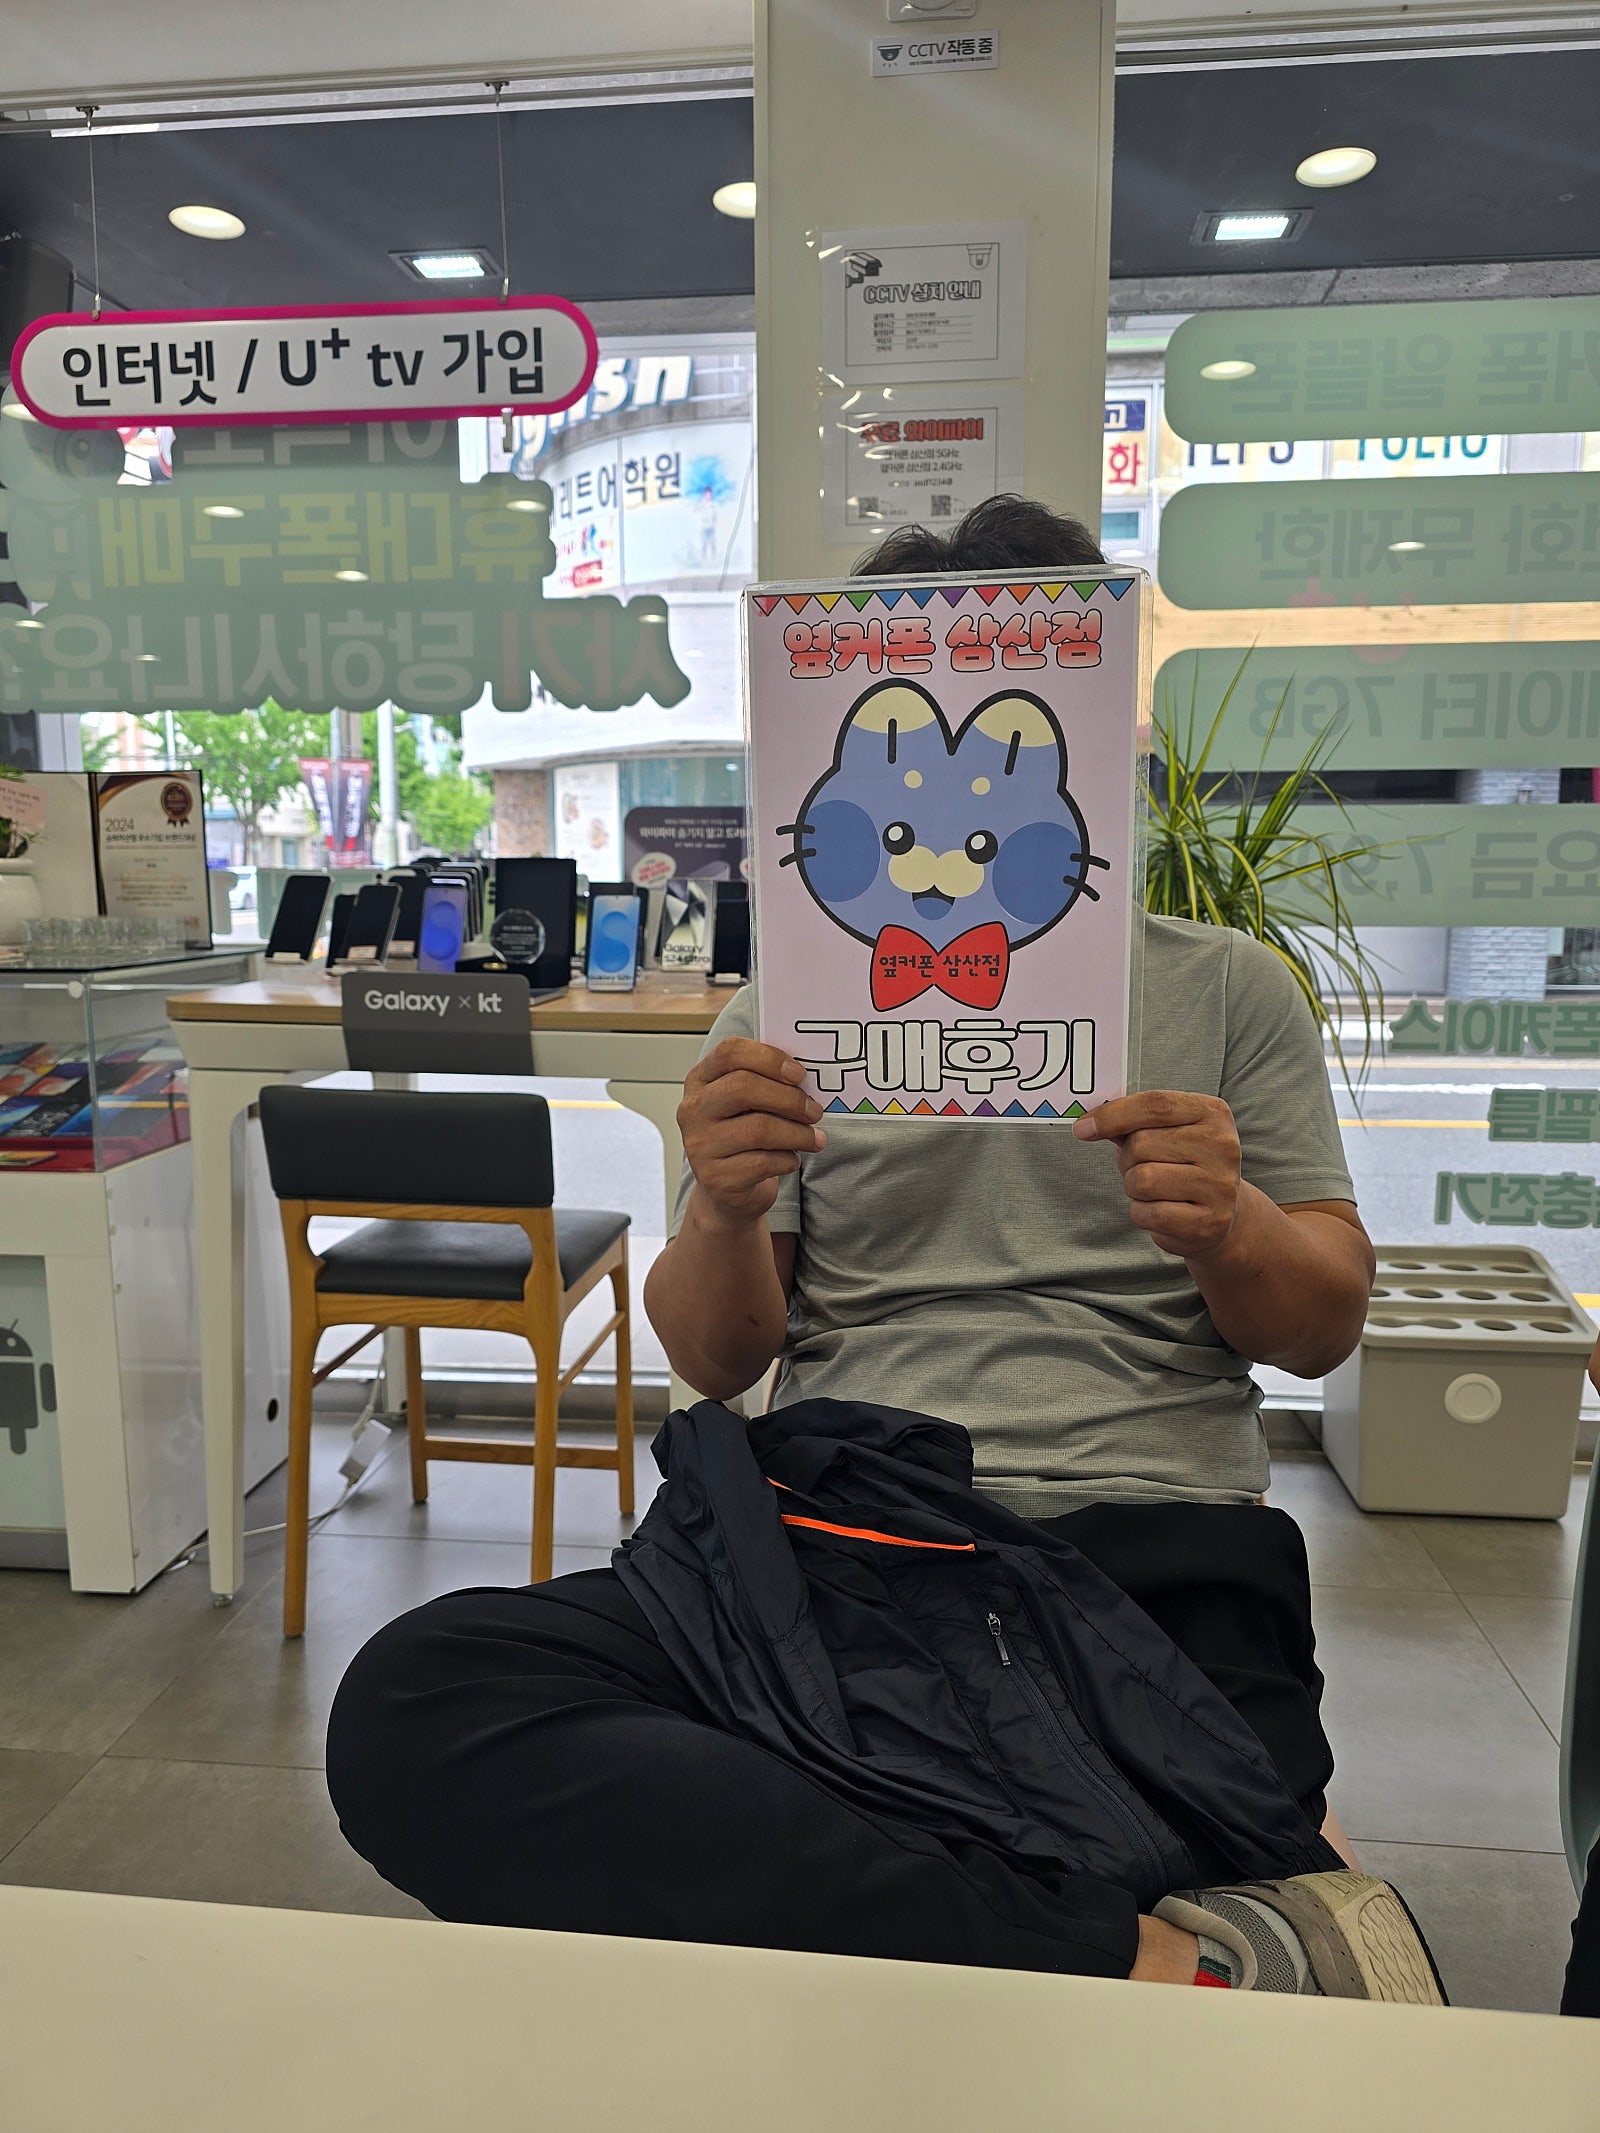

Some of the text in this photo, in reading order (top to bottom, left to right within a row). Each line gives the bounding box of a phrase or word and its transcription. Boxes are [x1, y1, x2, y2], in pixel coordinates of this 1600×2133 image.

[908, 37, 993, 57] CCTV 작동 중
[864, 280, 981, 304] CCTV 설치 안내
[62, 338, 217, 407] 인터넷
[236, 338, 259, 394] /
[367, 342, 424, 387] tv
[442, 326, 545, 395] 가입
[904, 417, 984, 442] 와이파이
[783, 608, 1103, 679] 옆커폰 삼산점
[879, 953, 1001, 978] 옆커폰 삼산점
[364, 989, 450, 1017] Galaxy
[477, 992, 503, 1013] kt
[793, 1018, 1096, 1095] 구매후기
